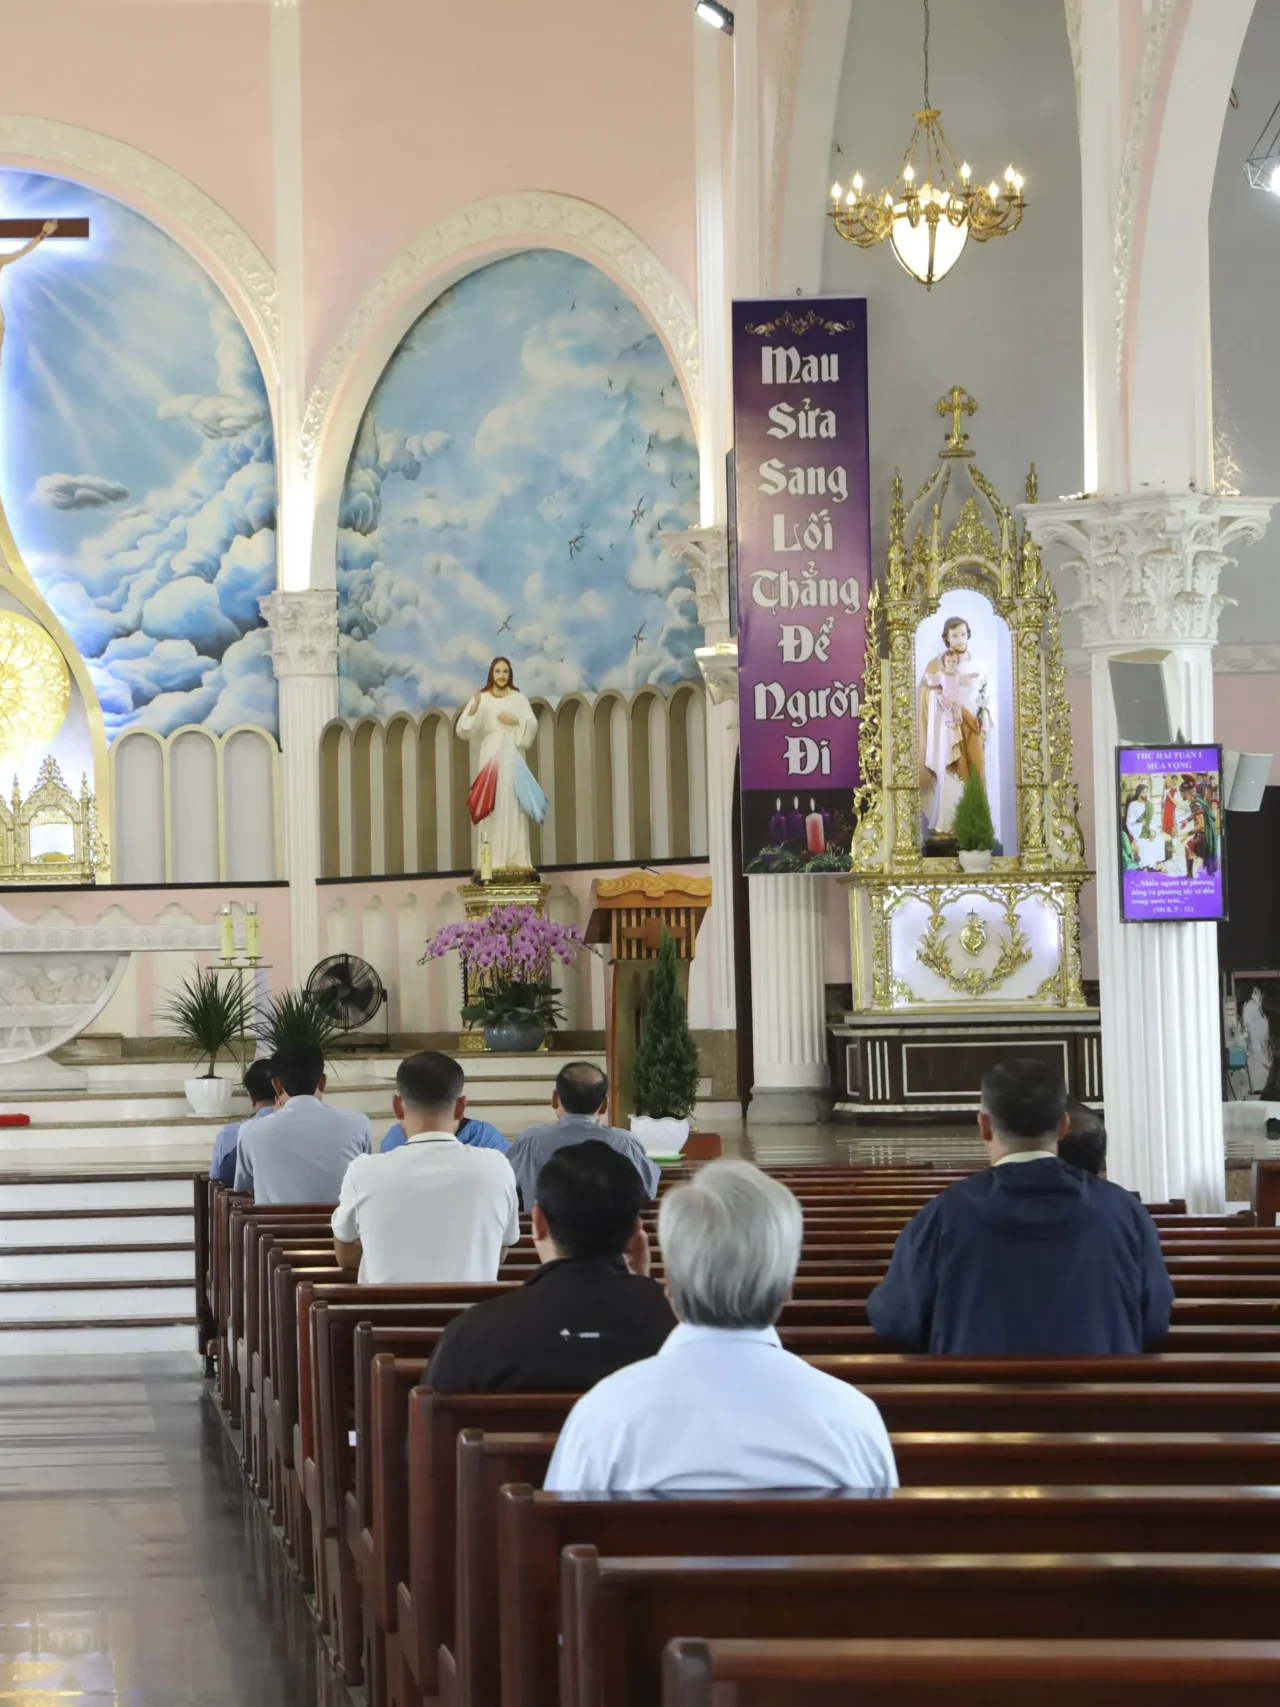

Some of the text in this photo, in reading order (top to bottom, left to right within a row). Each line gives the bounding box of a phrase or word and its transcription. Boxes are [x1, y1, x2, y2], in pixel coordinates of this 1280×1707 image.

[761, 346, 840, 384] Mau
[766, 398, 837, 439] Sửa
[758, 458, 848, 502] Sang
[773, 509, 834, 552] Lối
[749, 560, 860, 615] Thẳng
[777, 616, 835, 663] Để
[753, 680, 860, 728] Người
[782, 734, 831, 775] Đi
[1156, 752, 1171, 760] HAI
[1167, 761, 1192, 770] VỌNG
